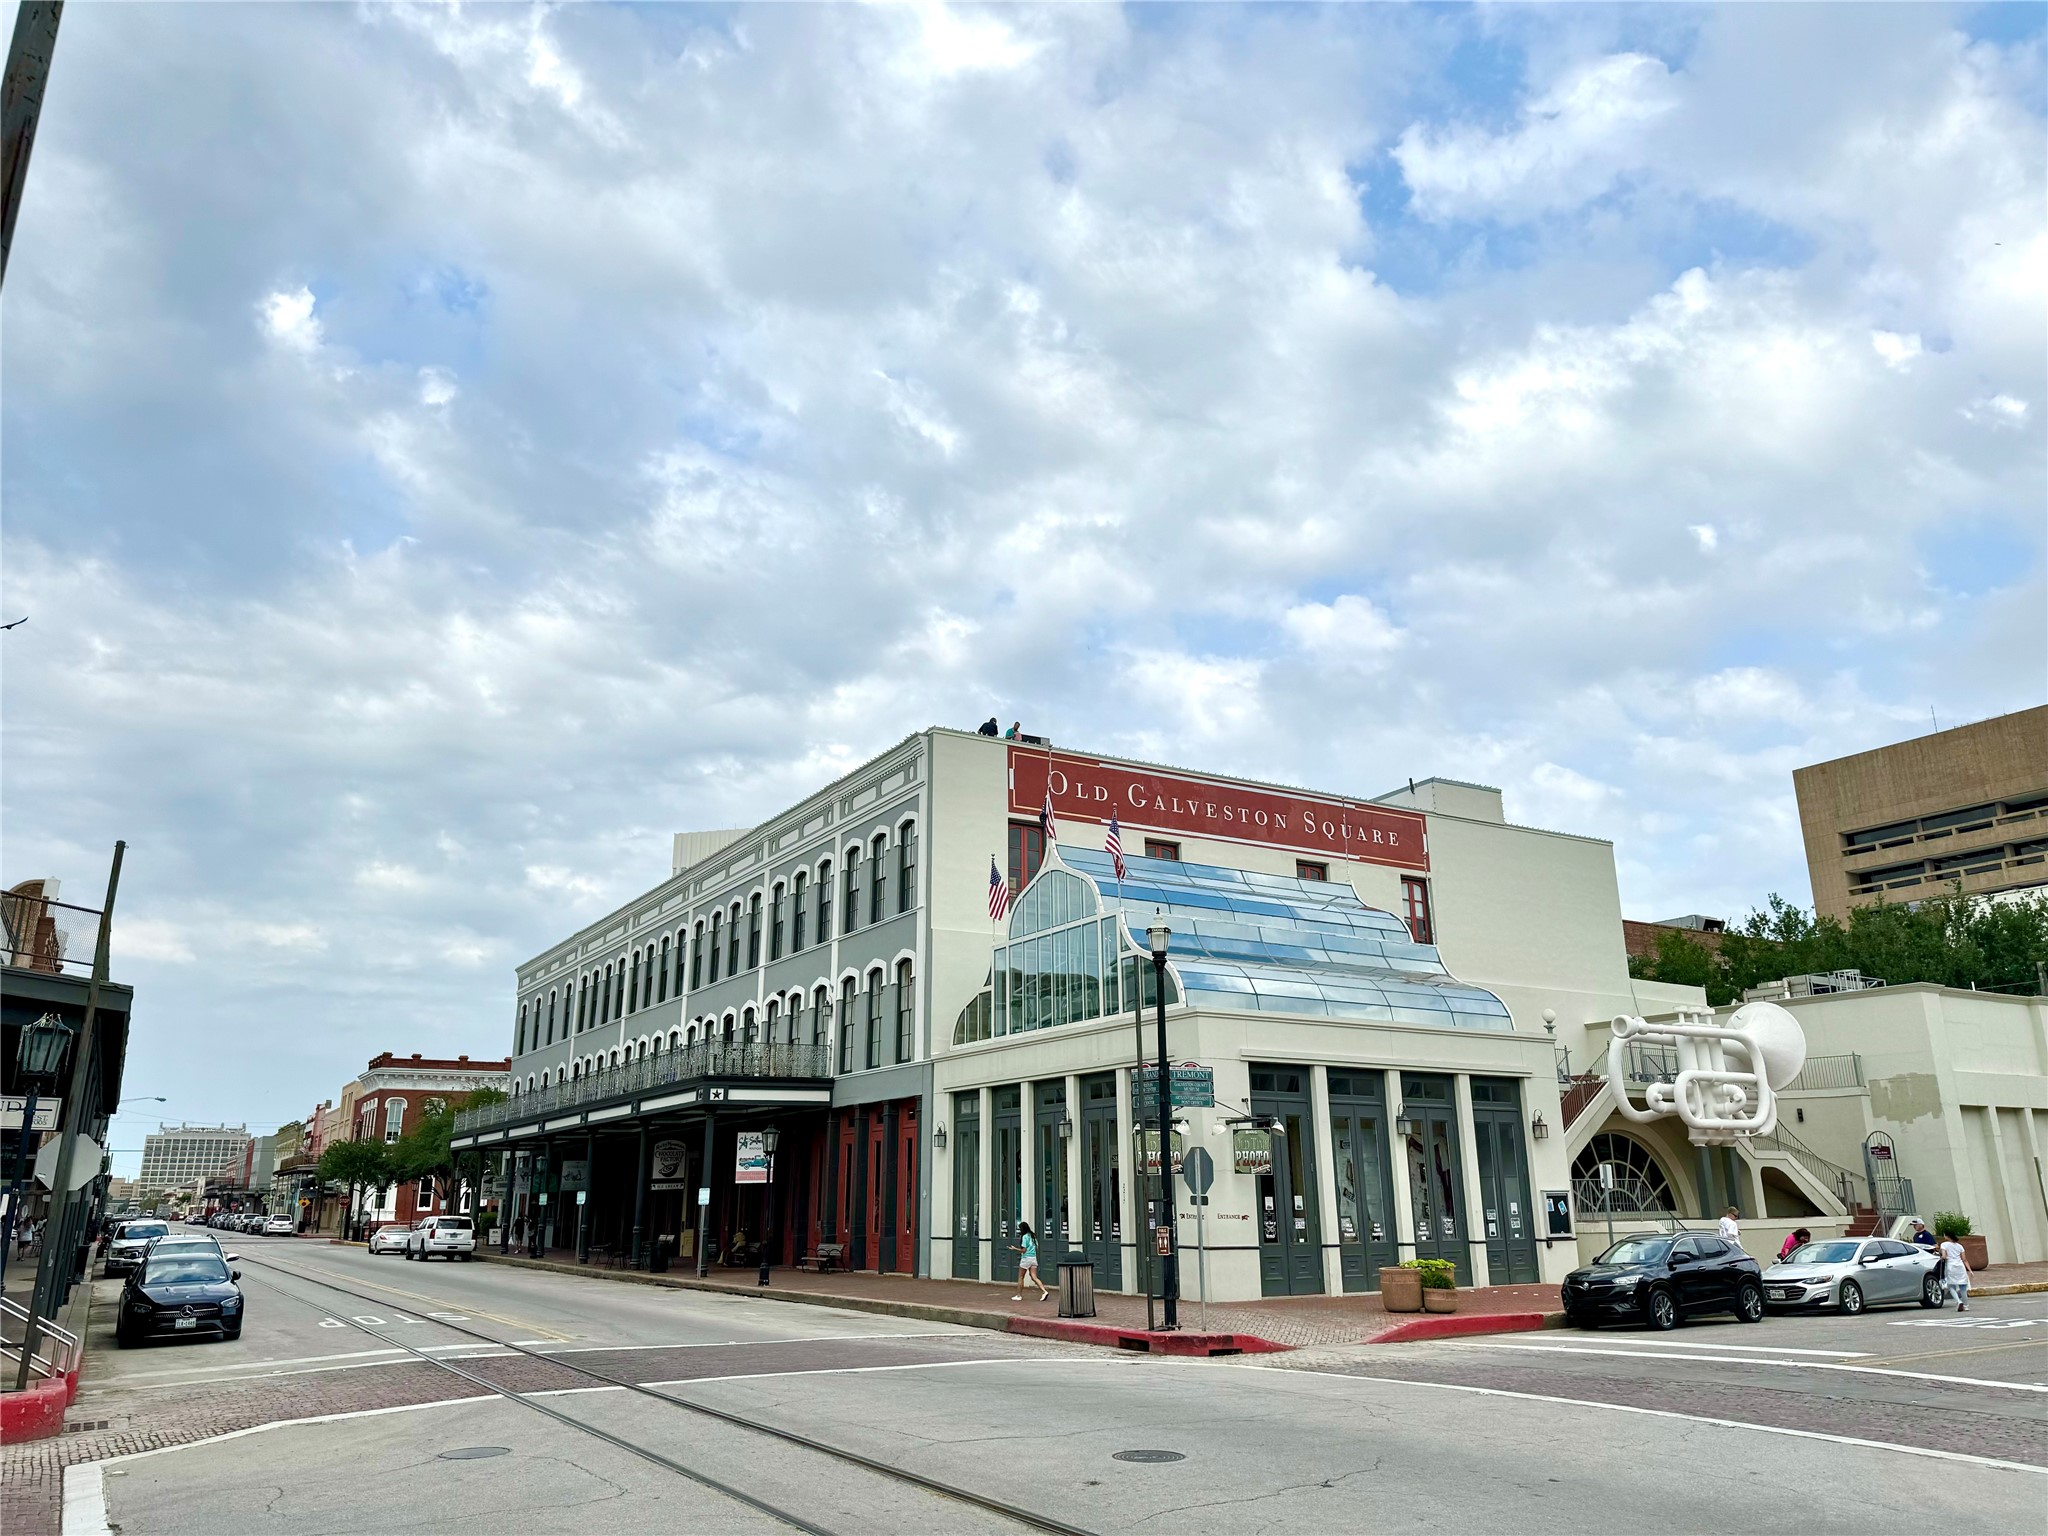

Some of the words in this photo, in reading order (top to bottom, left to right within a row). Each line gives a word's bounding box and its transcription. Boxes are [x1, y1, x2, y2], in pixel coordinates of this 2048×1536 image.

[1048, 770, 1109, 802] OLD
[1128, 783, 1288, 829] GALVESTON
[1304, 811, 1399, 847] SQUARE
[1172, 1071, 1210, 1079] TREMONT
[1235, 1150, 1270, 1166] PHOTO
